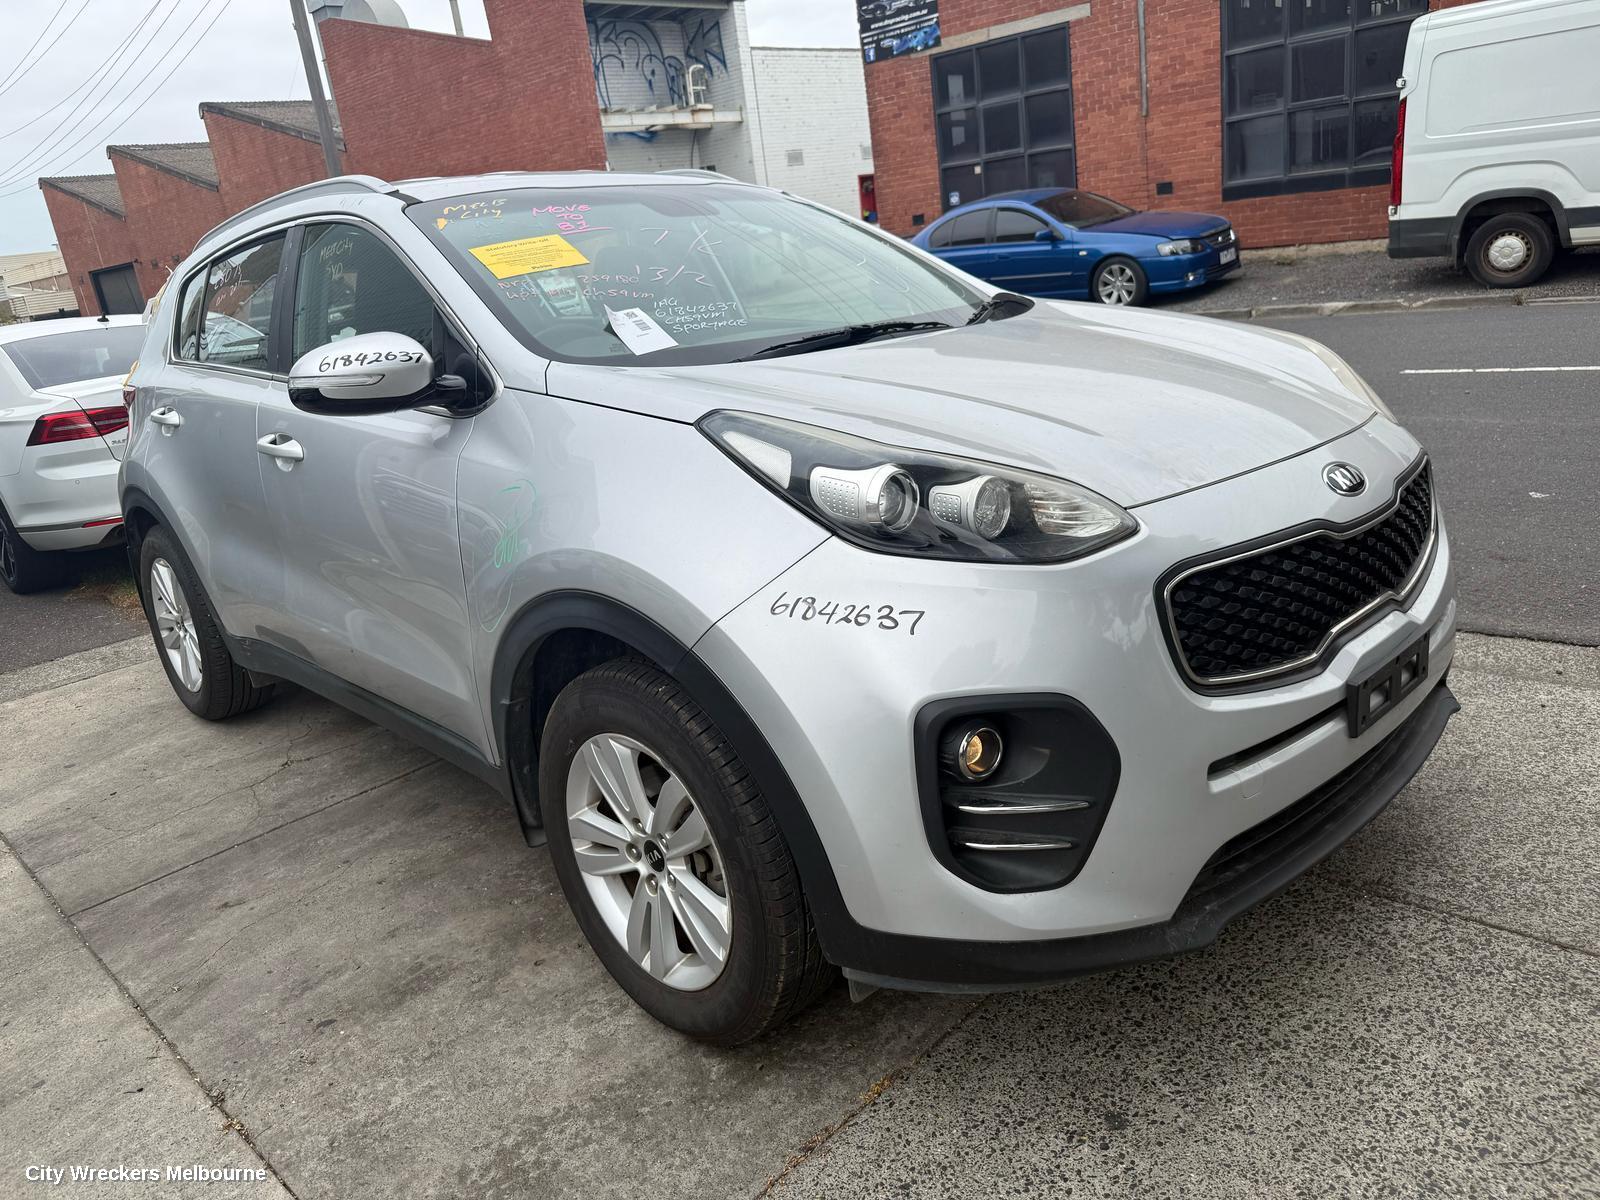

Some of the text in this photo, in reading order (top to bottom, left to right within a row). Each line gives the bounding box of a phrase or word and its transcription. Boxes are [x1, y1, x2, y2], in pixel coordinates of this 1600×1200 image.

[655, 302, 737, 318] 61842637
[318, 352, 424, 373] 61842637
[770, 591, 926, 636] 61842637
